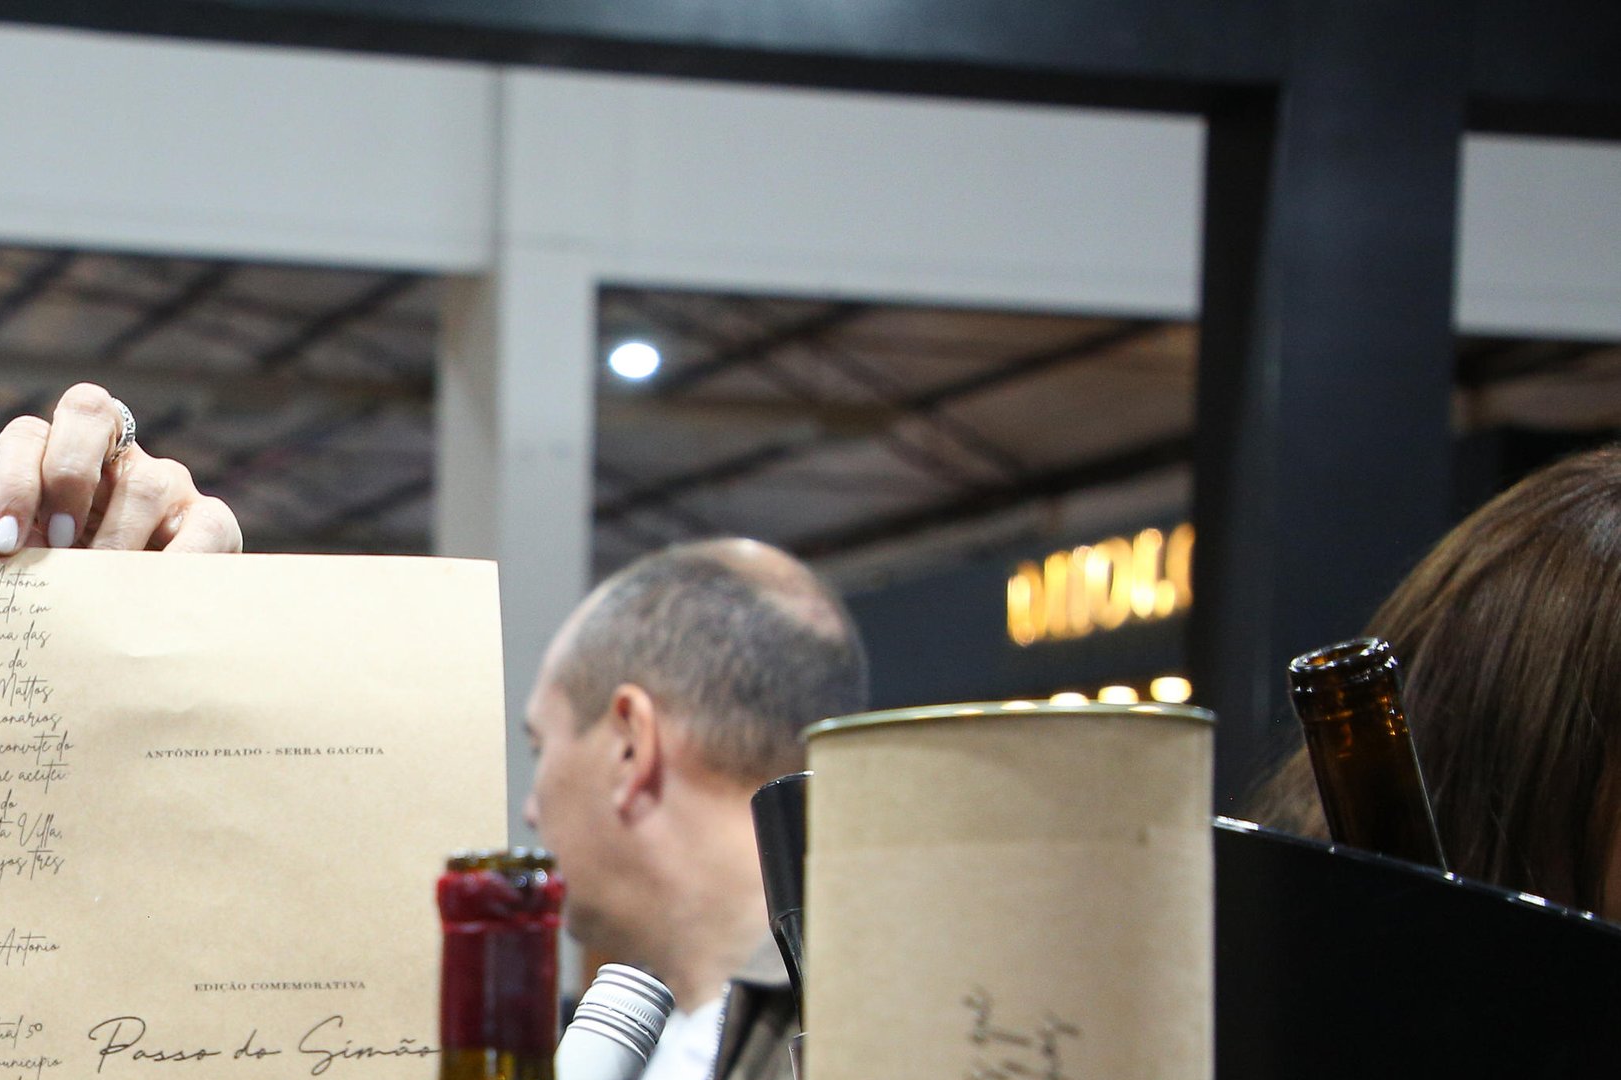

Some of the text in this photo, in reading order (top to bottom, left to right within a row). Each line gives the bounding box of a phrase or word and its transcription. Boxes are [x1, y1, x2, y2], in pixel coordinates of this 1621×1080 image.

[29, 606, 51, 614] em
[23, 621, 51, 649] das
[145, 746, 209, 759] ANTÔNIO
[214, 746, 264, 758] PRADO
[275, 746, 322, 756] SERRA
[327, 745, 385, 756] GAÚCHA
[1, 789, 18, 820] do
[194, 980, 367, 993] EDIÇÃO COMEMORATIVA
[89, 1016, 443, 1075] Passo do Simão
